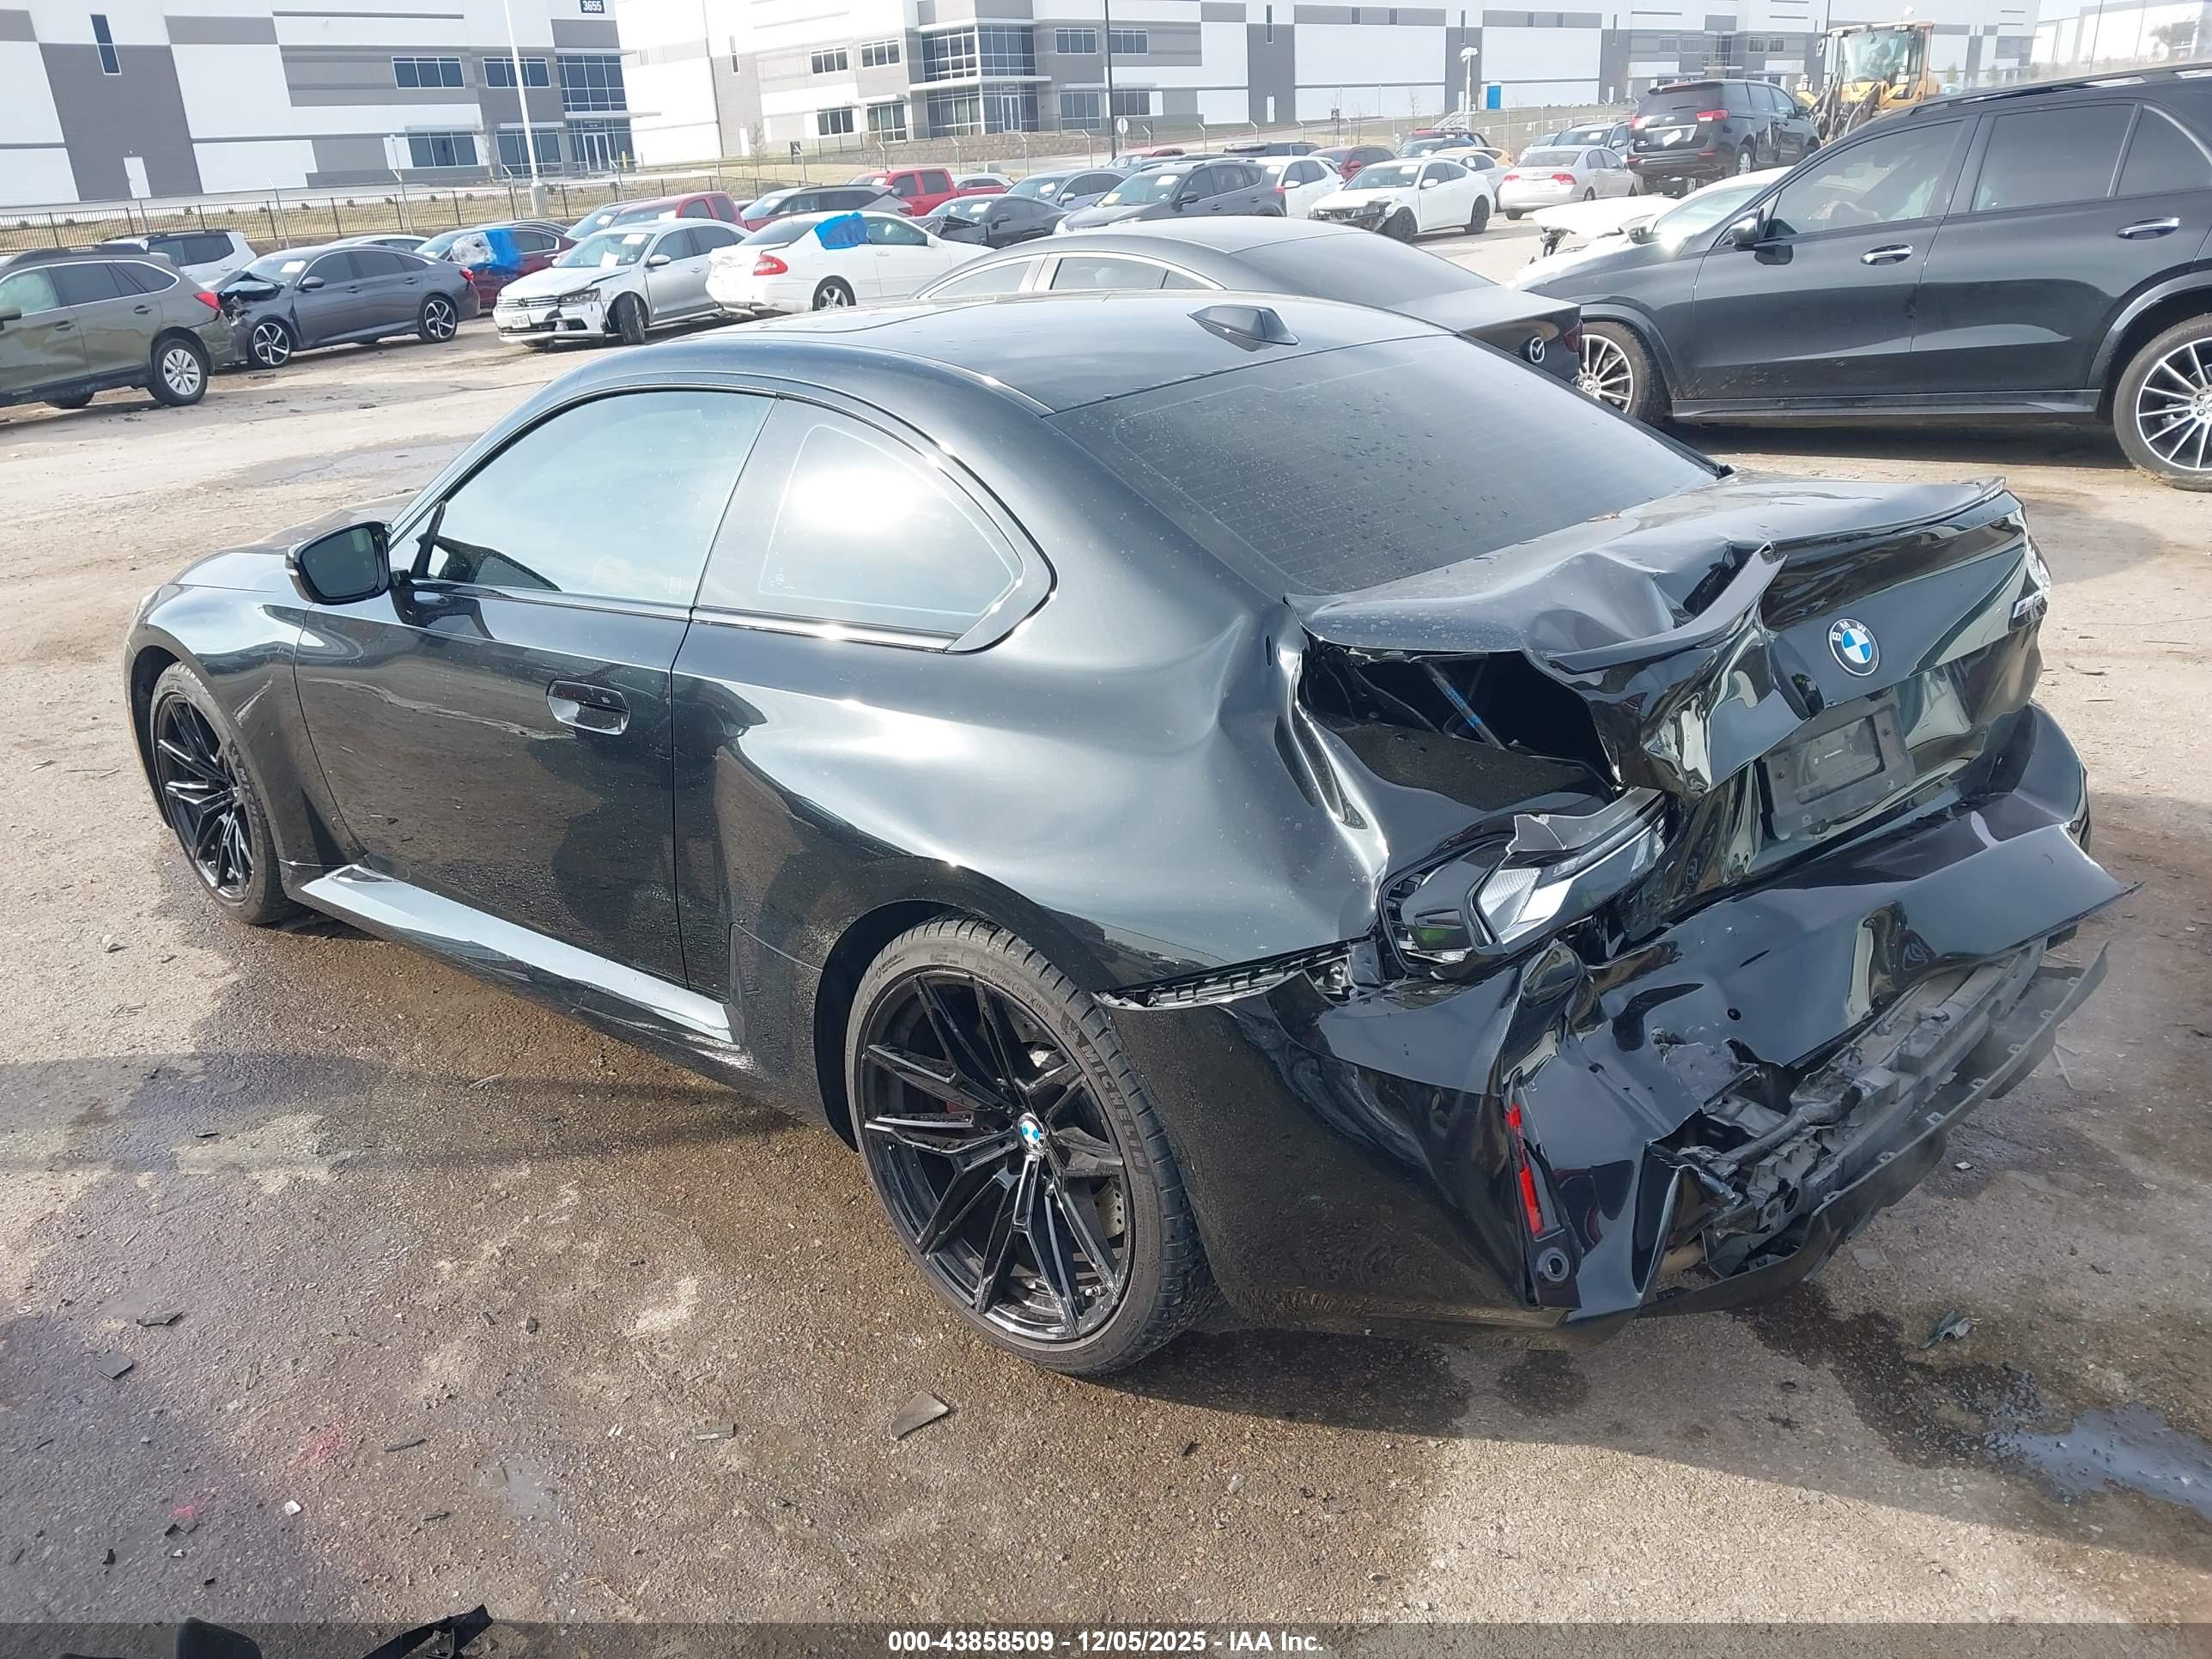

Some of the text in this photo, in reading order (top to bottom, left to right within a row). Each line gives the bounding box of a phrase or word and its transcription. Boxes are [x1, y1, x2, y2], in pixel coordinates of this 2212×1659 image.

[582, 0, 603, 11] 3655
[1832, 620, 1867, 642] BMW
[1079, 1044, 1148, 1169] MICHELIN
